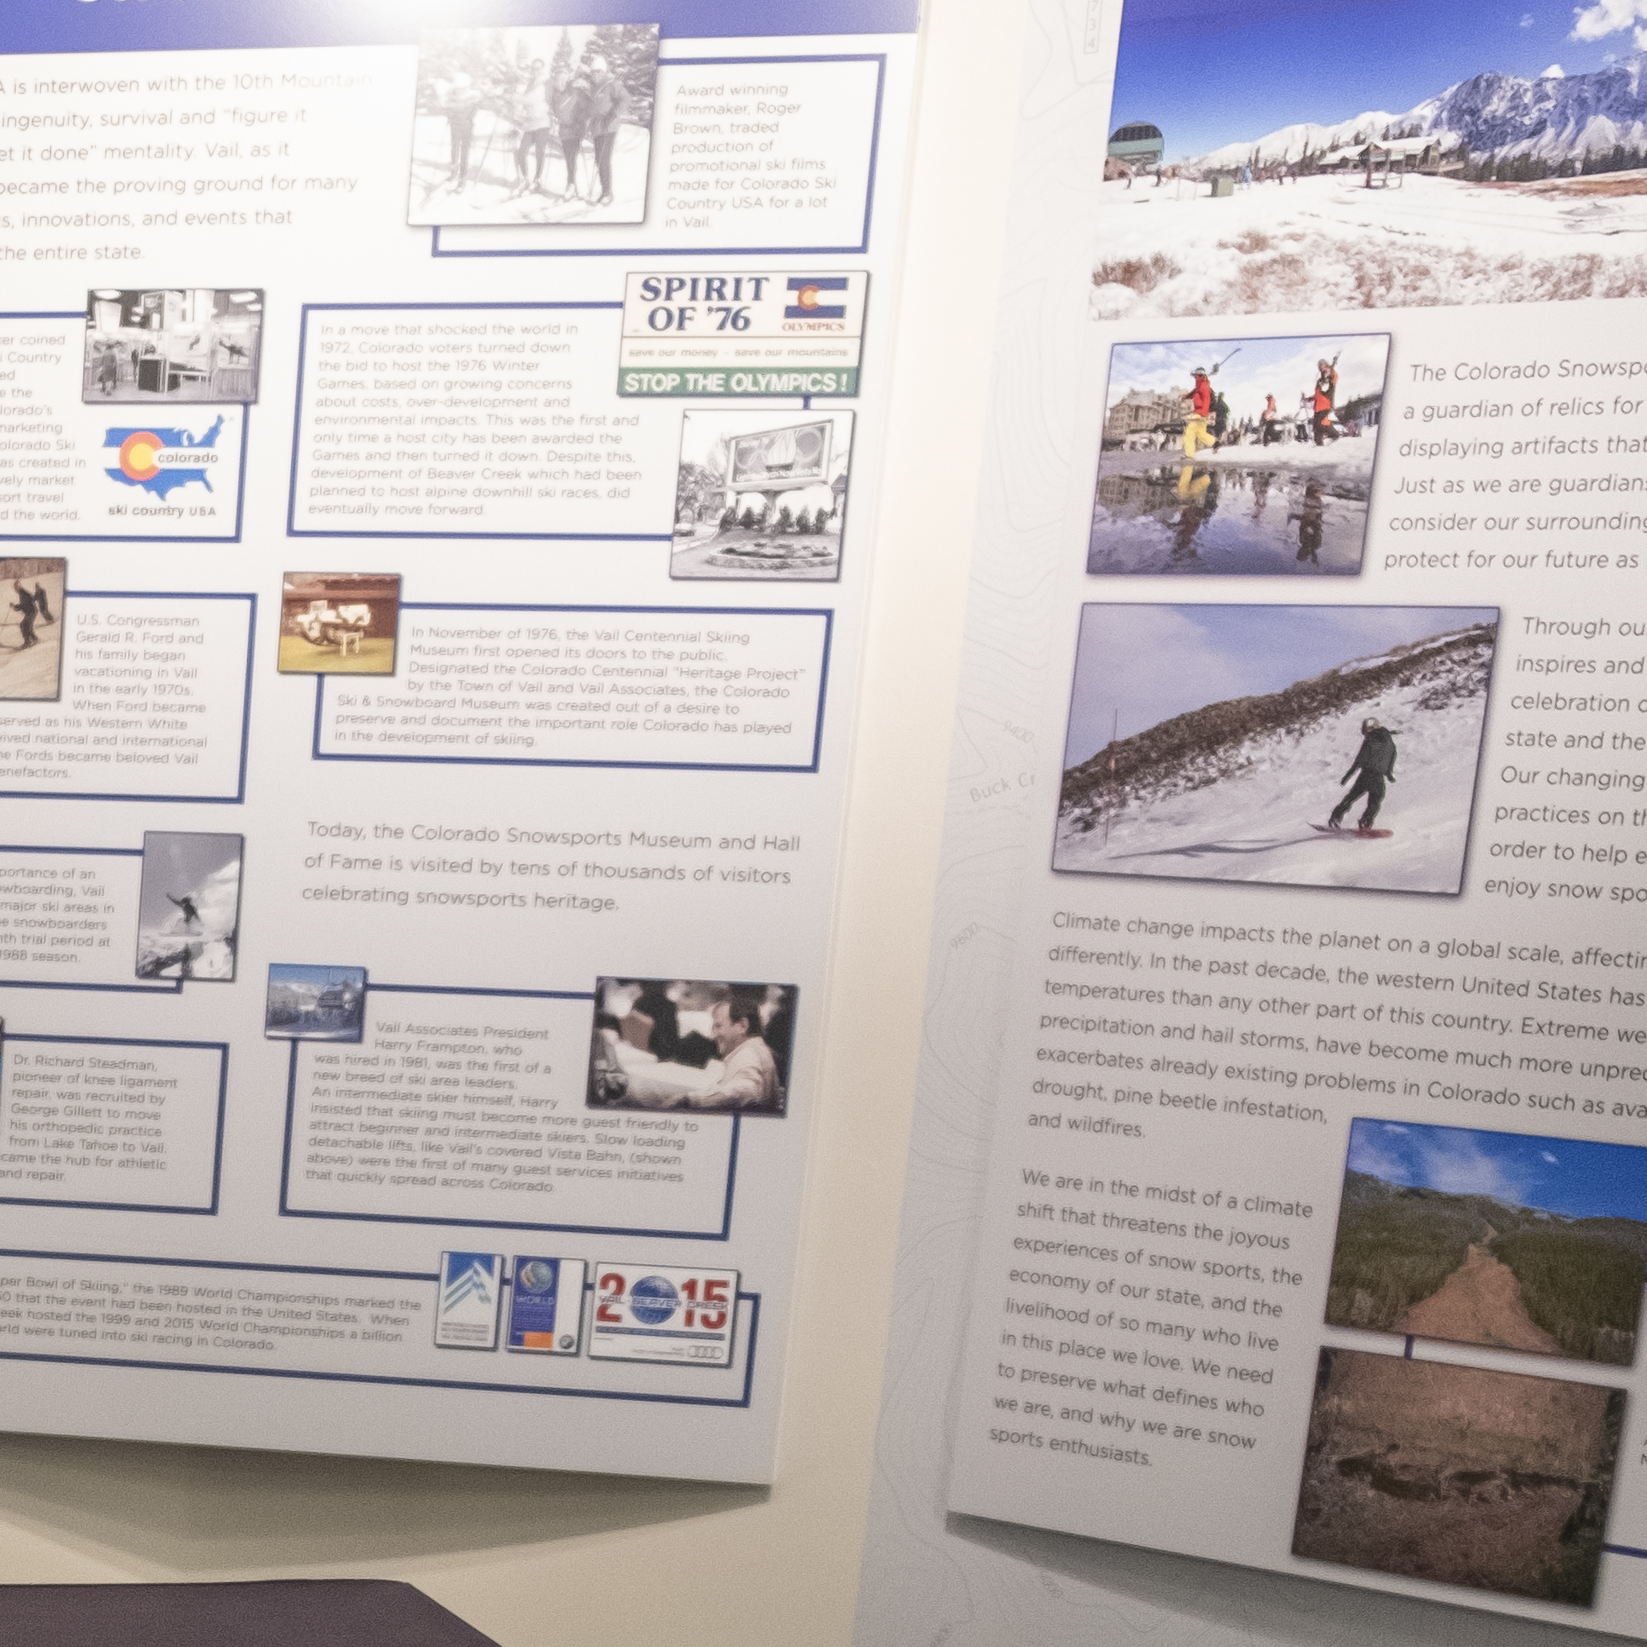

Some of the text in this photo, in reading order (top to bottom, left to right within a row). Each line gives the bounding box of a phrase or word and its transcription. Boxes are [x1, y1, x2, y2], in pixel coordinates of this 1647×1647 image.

[32, 245, 88, 261] entire
[94, 245, 146, 260] state.
[640, 276, 769, 302] SPIRIT
[647, 305, 751, 331] OF '76
[624, 372, 681, 392] STOP
[684, 372, 726, 392] THE
[157, 452, 219, 463] colorado
[108, 504, 216, 519] ski country USA
[307, 820, 800, 852] Today, the Colorado Snowsports Museum and Hall
[301, 885, 619, 913] celebrating snowsports heritage.
[1031, 1078, 1327, 1124] drought, pine beetle infestation,
[1027, 1112, 1145, 1138] and wildfires.
[1022, 1168, 1313, 1219] We are in the midst of a climate
[989, 1428, 1152, 1466] sports enthusiasts.
